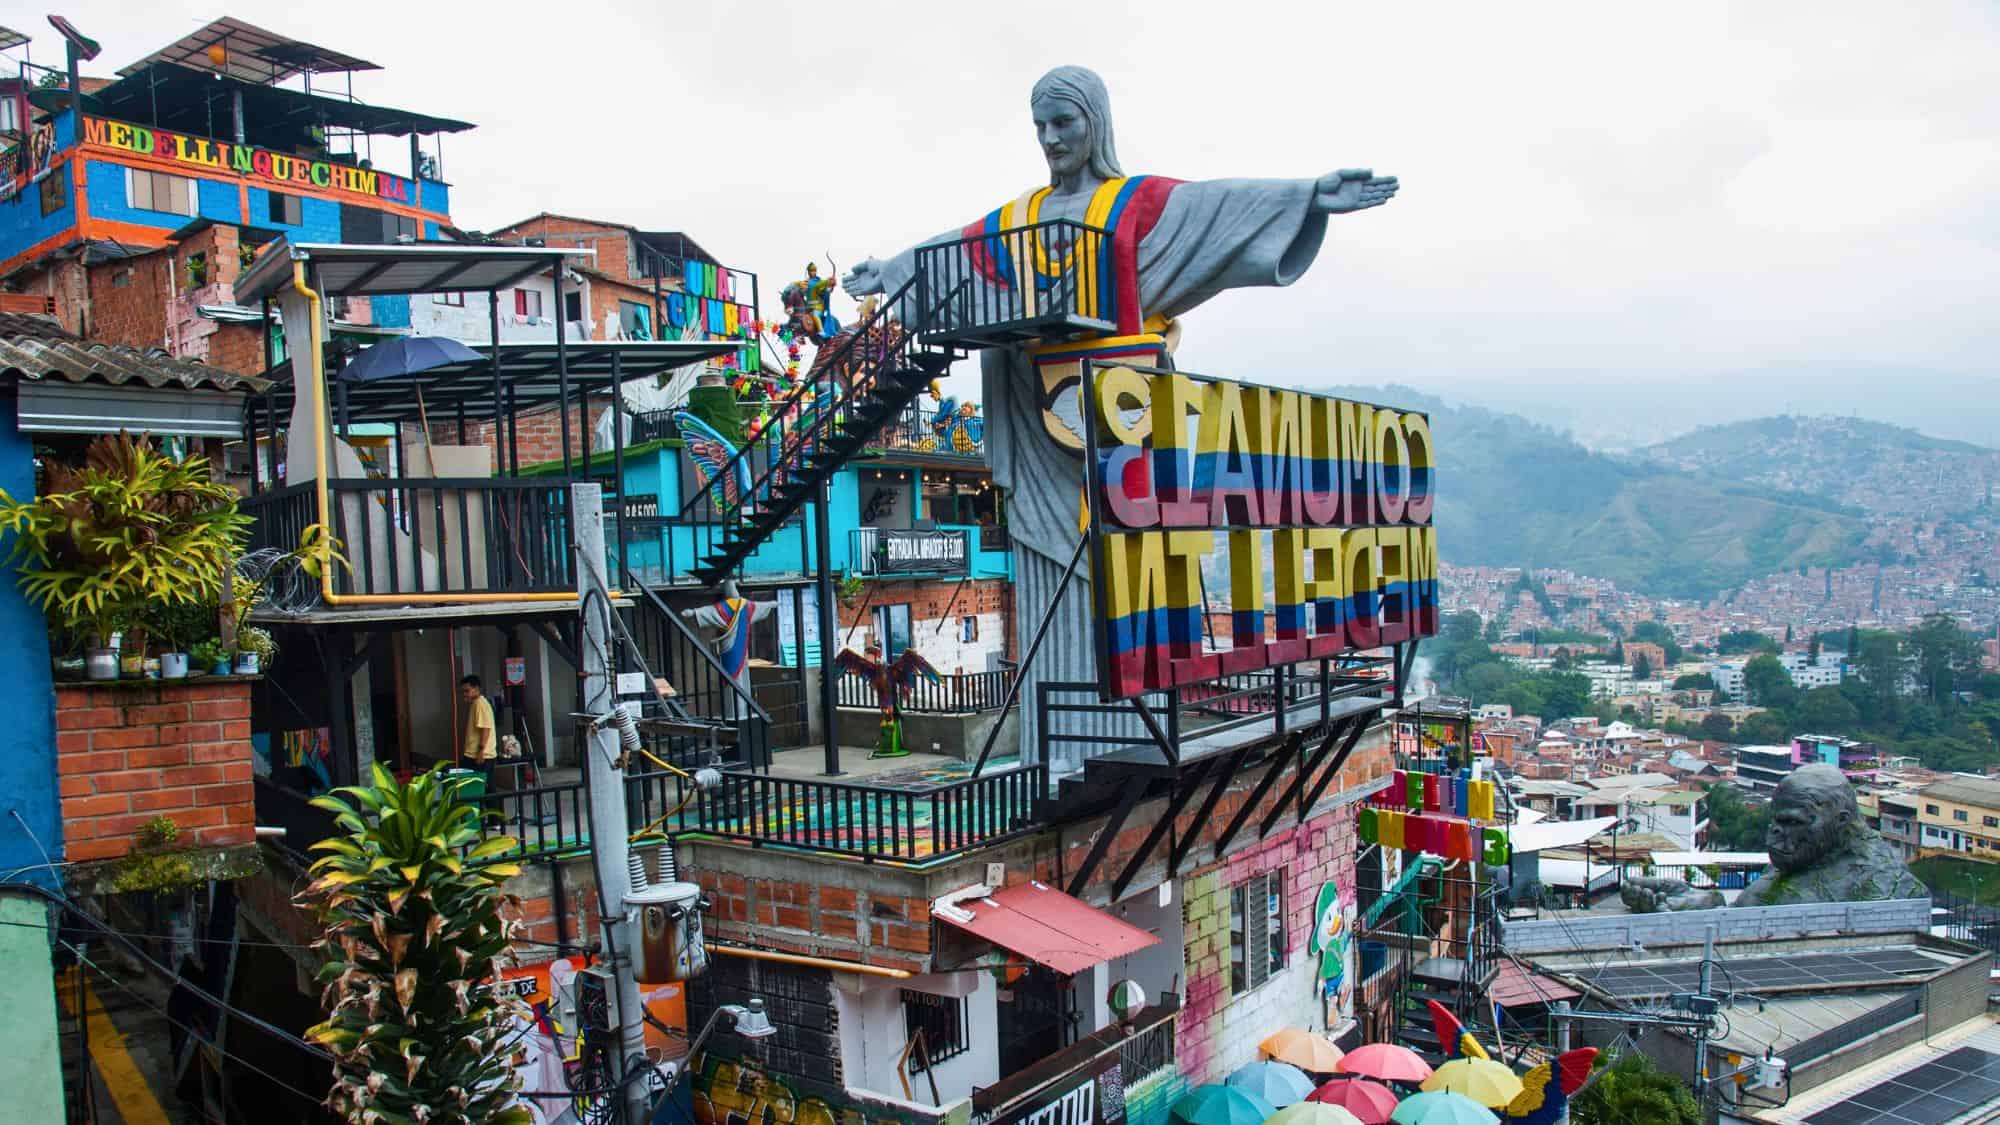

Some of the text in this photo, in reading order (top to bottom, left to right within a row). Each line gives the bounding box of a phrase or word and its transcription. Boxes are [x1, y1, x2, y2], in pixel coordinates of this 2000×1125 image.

[684, 260, 732, 303] UNA
[888, 538, 912, 560] ENTRADA
[913, 538, 920, 560] AL
[921, 538, 943, 560] MIRADOR
[520, 981, 537, 995] DE
